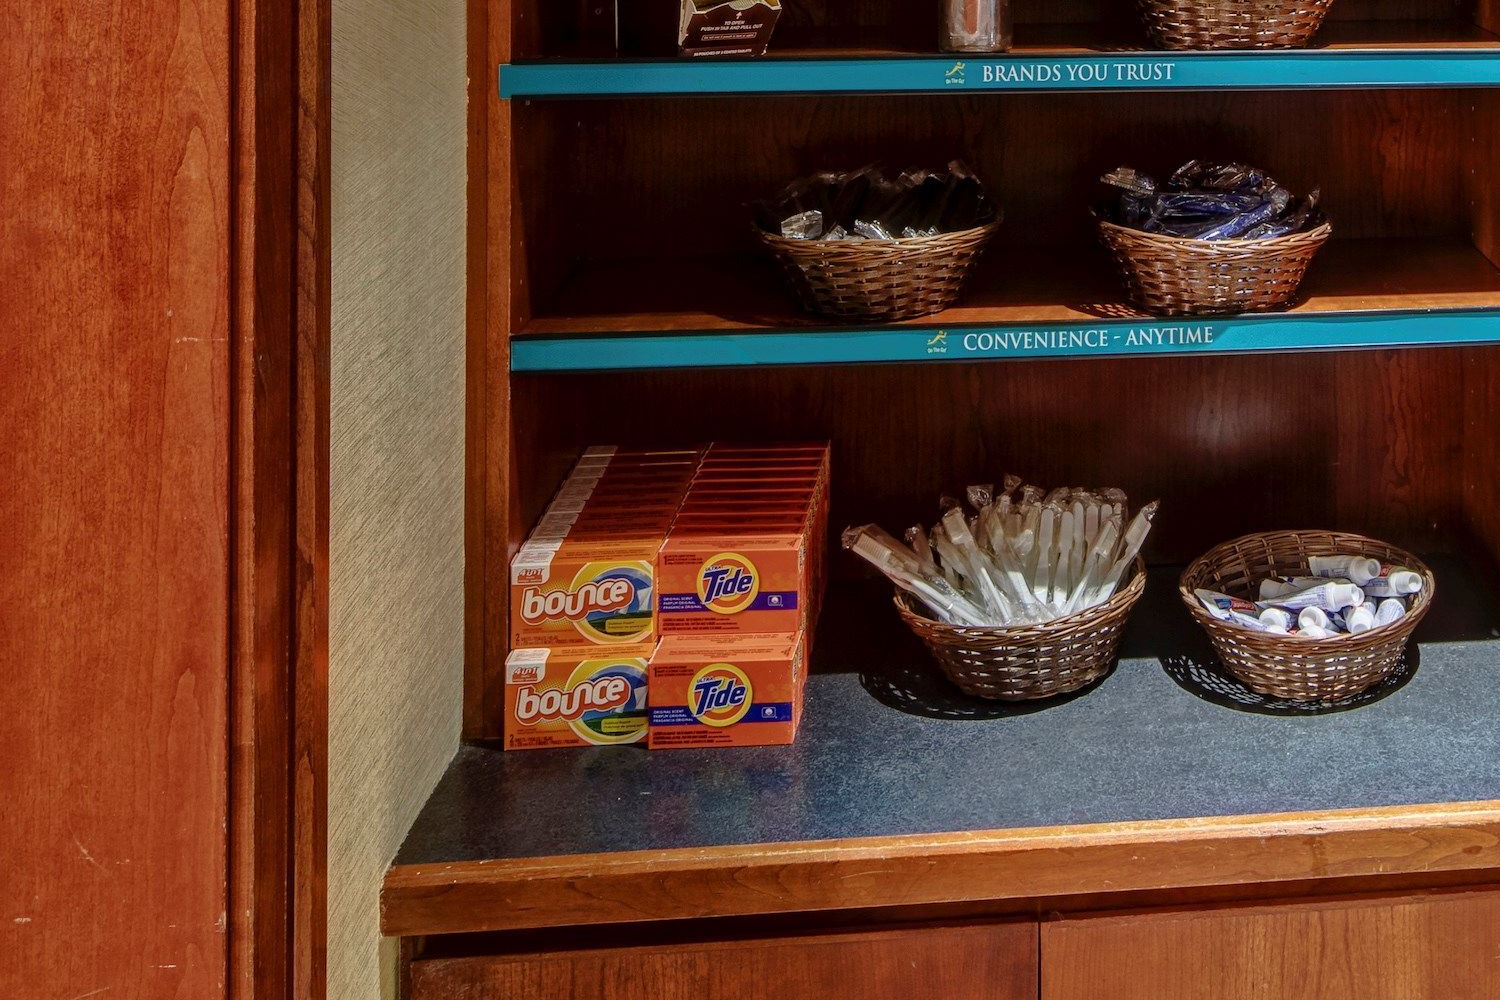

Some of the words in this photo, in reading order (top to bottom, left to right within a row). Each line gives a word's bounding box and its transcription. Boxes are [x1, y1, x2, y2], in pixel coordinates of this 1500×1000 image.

[983, 64, 1061, 83] BRANDS
[1066, 64, 1108, 81] YOU
[1113, 63, 1175, 80] TRUST
[963, 330, 1108, 351] CONVENIENCE
[1125, 326, 1214, 345] ANYTIME
[521, 579, 632, 623] bounce
[702, 568, 753, 604] Tide
[514, 667, 538, 675] 4in1
[516, 678, 628, 724] bounce
[694, 680, 746, 716] Tide
